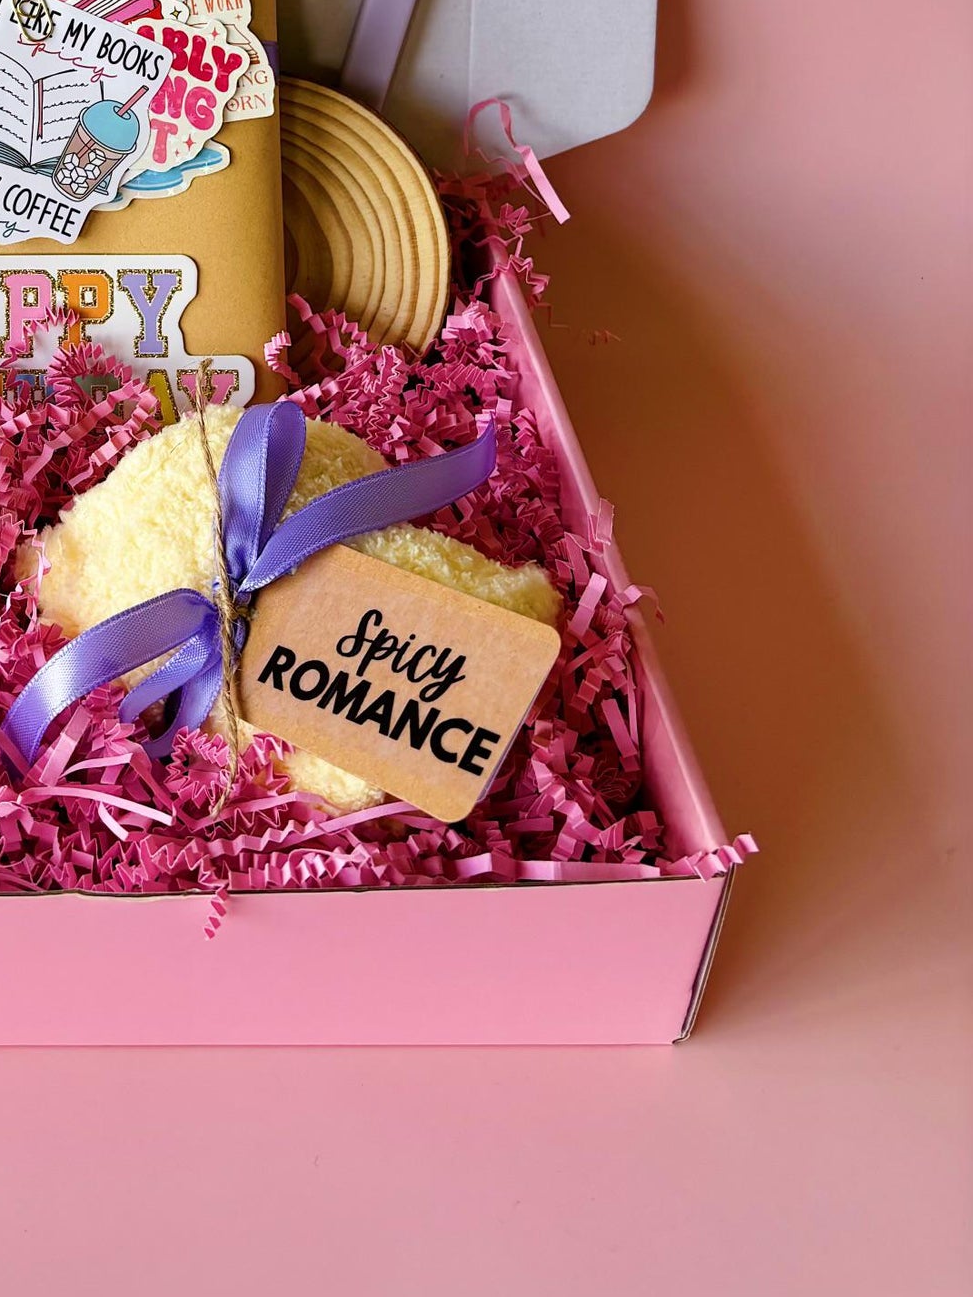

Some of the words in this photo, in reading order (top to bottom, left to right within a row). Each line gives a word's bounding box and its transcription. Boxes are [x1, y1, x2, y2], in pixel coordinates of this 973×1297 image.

[61, 18, 96, 52] MY
[96, 32, 165, 81] BOOKS
[3, 184, 81, 238] COFFEE
[336, 609, 467, 703] Spicy
[257, 645, 501, 777] ROMANCE
